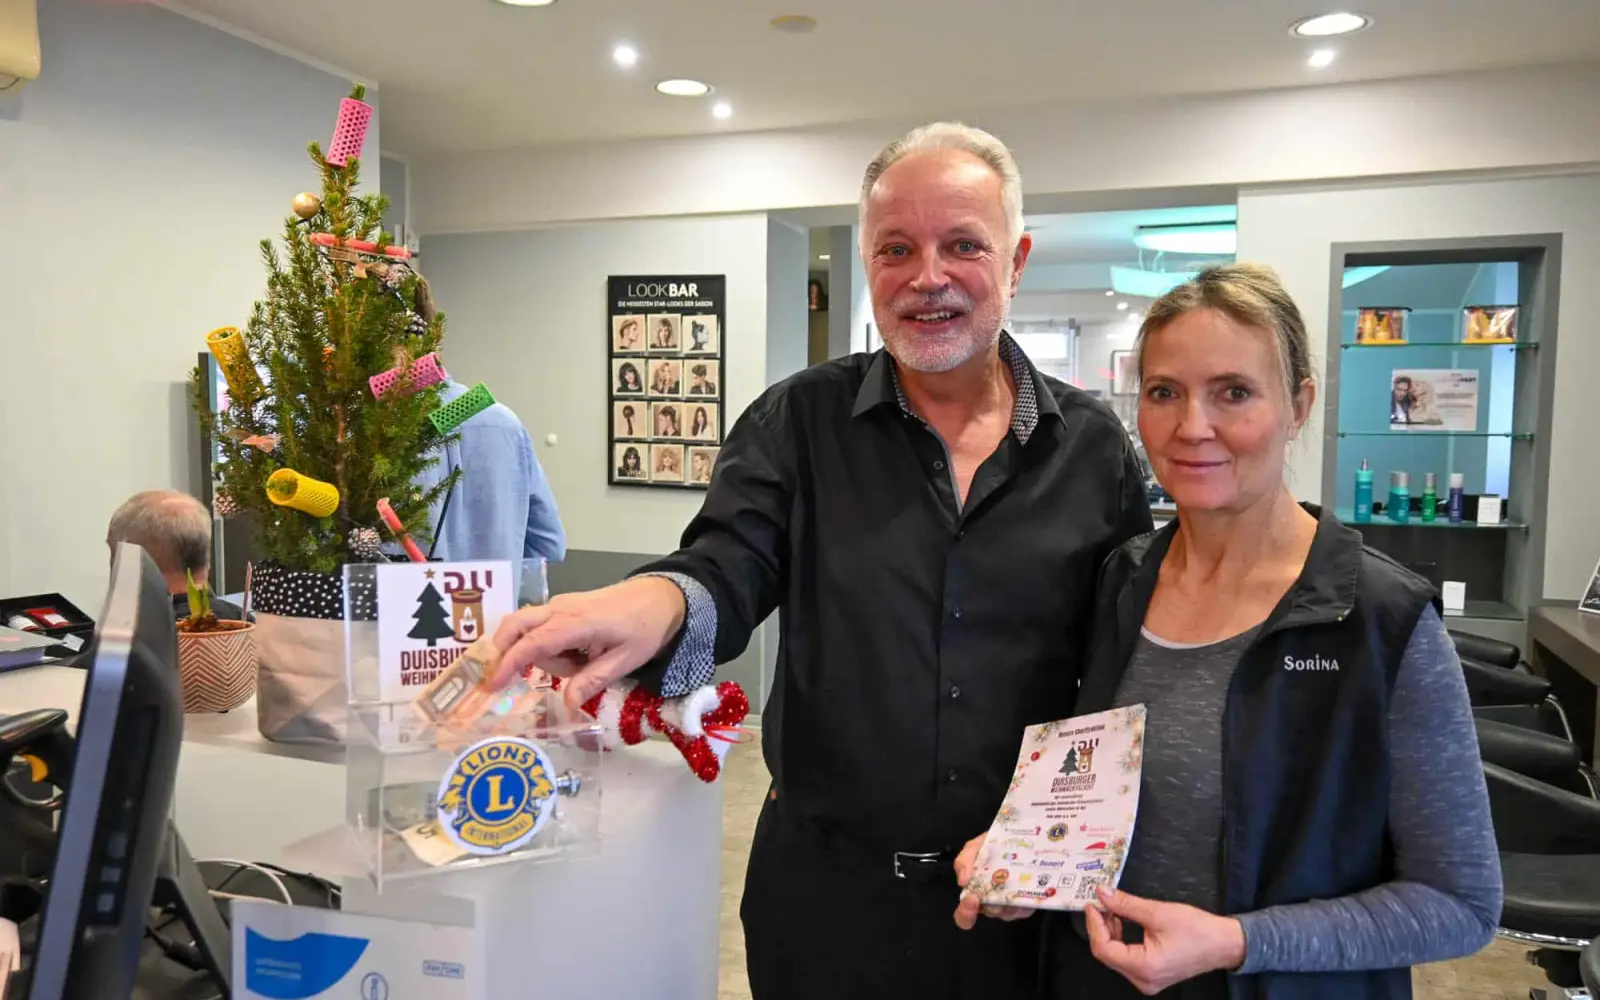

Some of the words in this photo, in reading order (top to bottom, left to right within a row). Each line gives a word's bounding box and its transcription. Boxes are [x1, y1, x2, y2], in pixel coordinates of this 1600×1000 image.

[401, 670, 442, 686] WEIHN
[466, 745, 531, 770] LIONS
[485, 774, 515, 813] L
